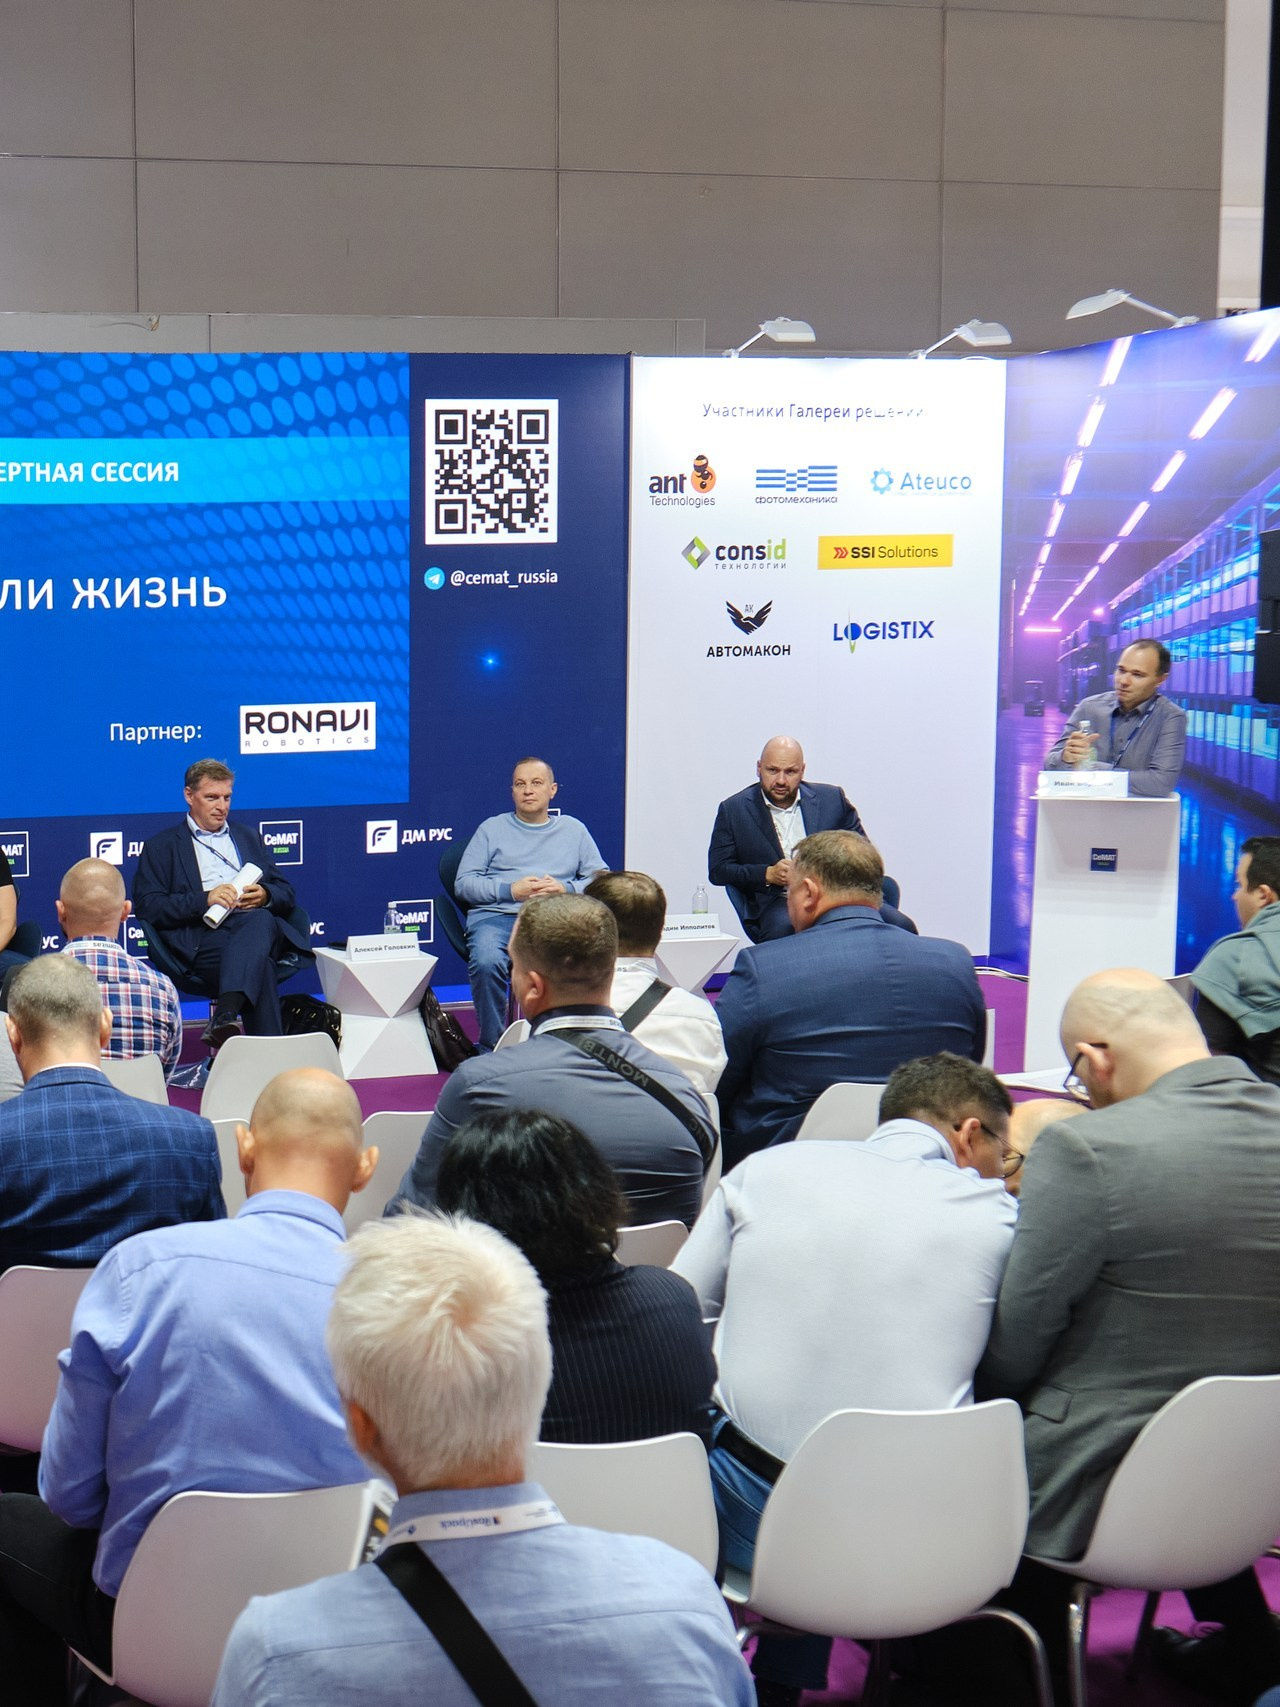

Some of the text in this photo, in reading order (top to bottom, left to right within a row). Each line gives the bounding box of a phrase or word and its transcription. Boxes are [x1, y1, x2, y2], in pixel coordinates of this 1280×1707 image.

[703, 403, 784, 418] Участники
[789, 404, 851, 422] Галереи
[90, 461, 180, 483] СЕССИЯ
[649, 473, 687, 494] ant
[899, 471, 972, 490] Ateuco
[650, 495, 716, 508] Technologies
[755, 495, 838, 506] фотомеханика
[715, 538, 787, 561] consid
[851, 545, 939, 559] SSI Solutions
[715, 562, 787, 570] технологии
[450, 568, 559, 588] @cemat_russia
[71, 575, 228, 610] жизнь
[833, 620, 935, 642] LOGISTIX
[706, 644, 791, 658] АВТОМАКОН
[245, 708, 370, 735] RONAVI
[109, 721, 203, 746] Партнер:
[245, 736, 370, 748] ROBOTICS
[264, 832, 299, 846] CeMAT
[401, 827, 453, 845] ДМ РУС
[2, 844, 24, 857] MAT
[395, 911, 430, 925] CeMAT
[41, 935, 60, 950] УС
[354, 944, 383, 954] Алексей
